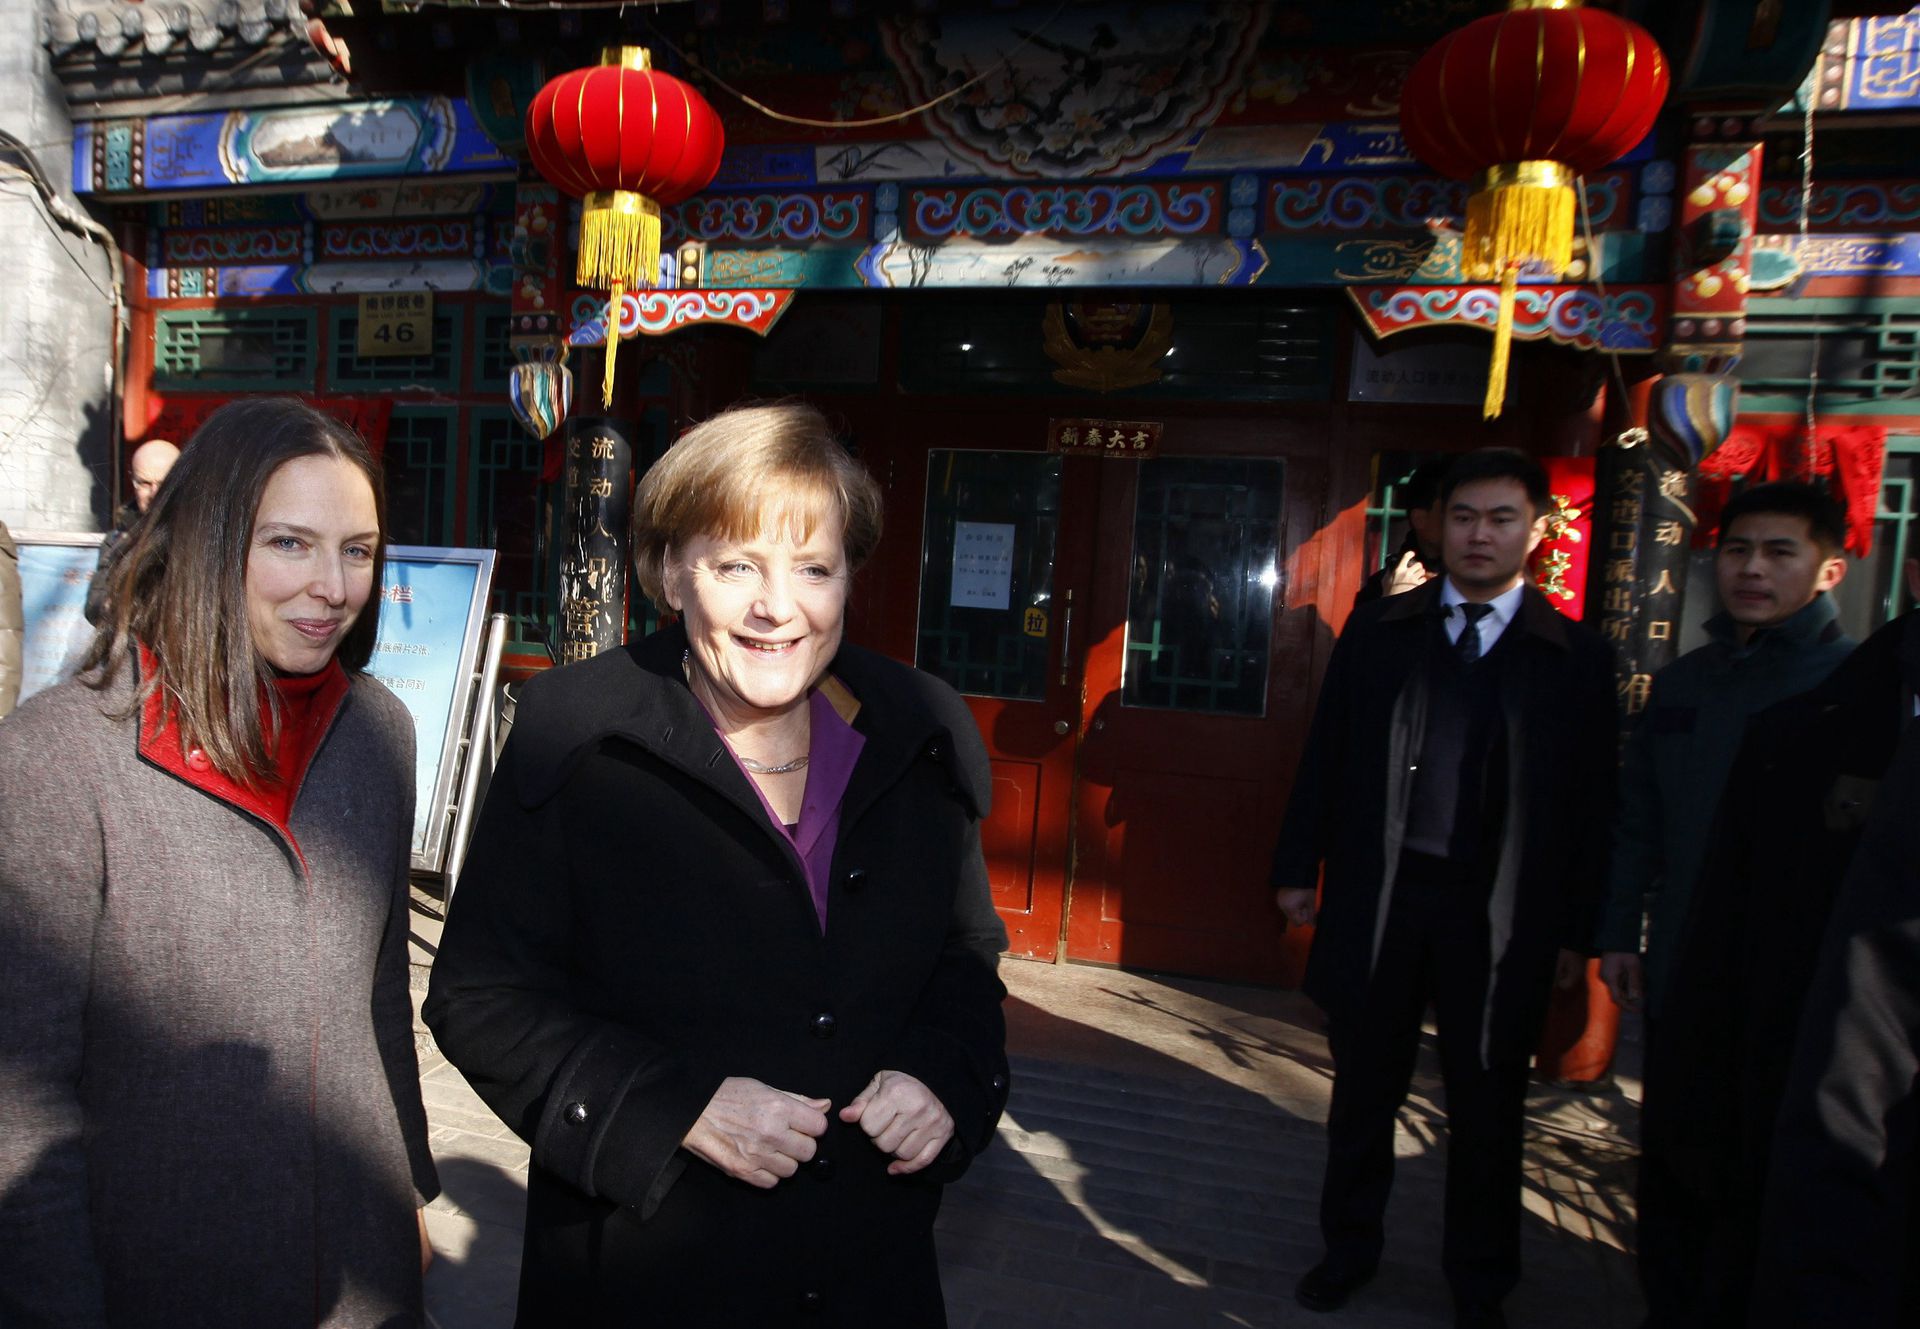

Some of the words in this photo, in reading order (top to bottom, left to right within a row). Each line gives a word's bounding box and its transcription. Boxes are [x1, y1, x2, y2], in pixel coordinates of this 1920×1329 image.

[373, 322, 415, 343] 46
[1061, 427, 1150, 449] 新春大吉
[1648, 470, 1688, 641] 流动人口
[1027, 613, 1044, 632] 拉
